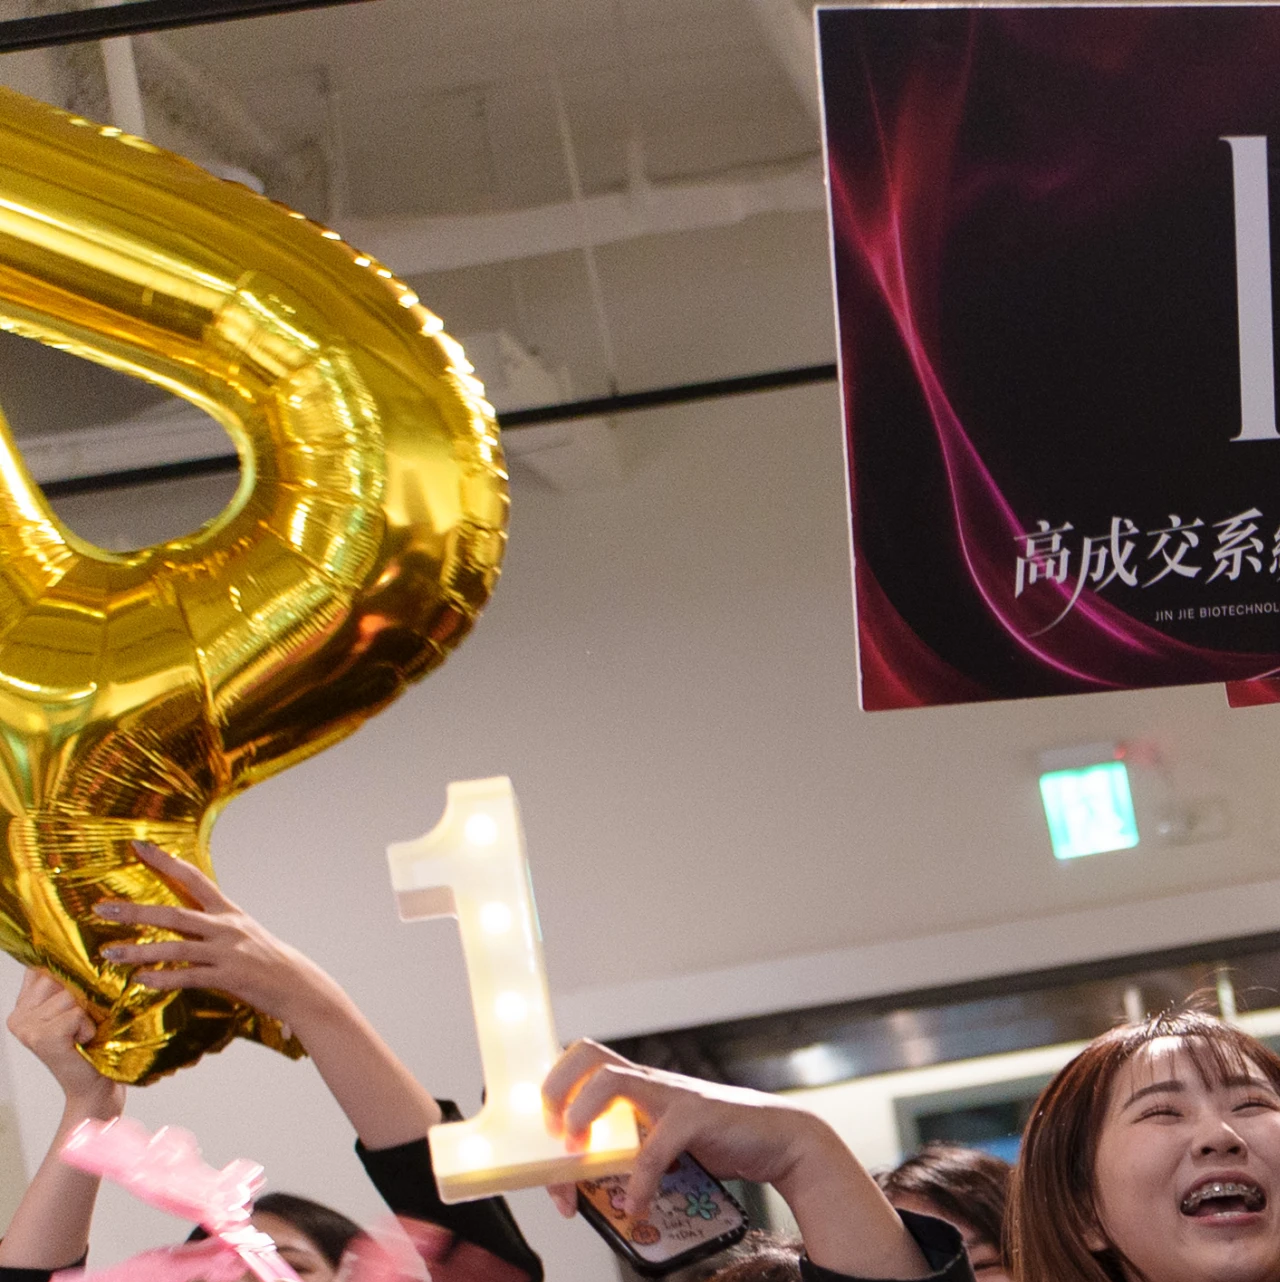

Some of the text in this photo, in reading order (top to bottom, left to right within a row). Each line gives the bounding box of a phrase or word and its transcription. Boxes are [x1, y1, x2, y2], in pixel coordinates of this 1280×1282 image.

[1155, 610, 1173, 622] JIN
[1178, 608, 1194, 620] JIE
[387, 775, 641, 1205] 1
